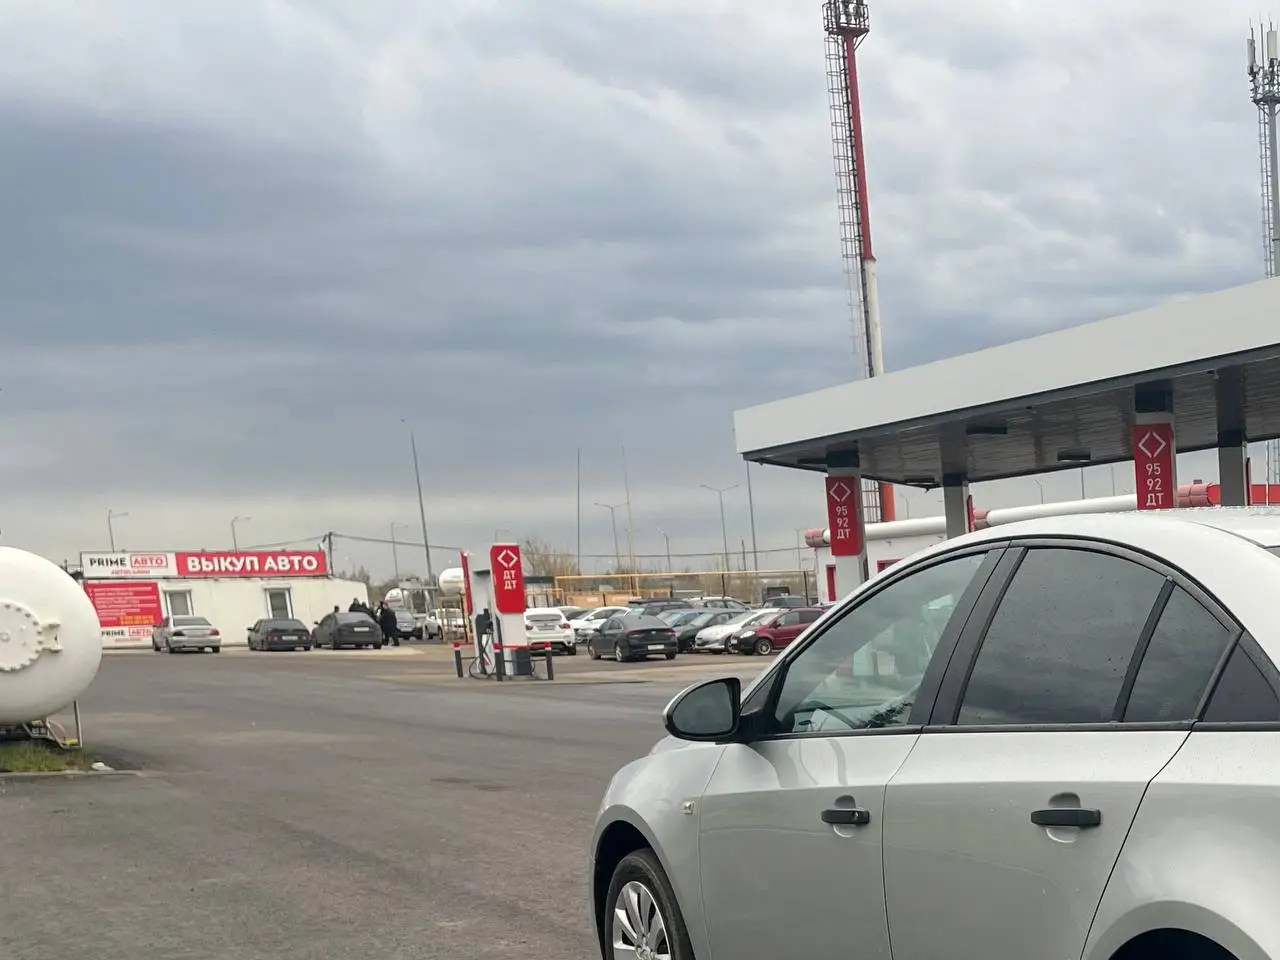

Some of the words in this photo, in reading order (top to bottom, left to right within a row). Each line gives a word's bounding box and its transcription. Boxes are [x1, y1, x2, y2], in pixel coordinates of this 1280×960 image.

[1146, 463, 1161, 476] 95
[1146, 478, 1162, 491] 92
[1146, 493, 1165, 507] ДТ
[835, 506, 848, 516] 95
[837, 518, 849, 528] 92
[836, 529, 851, 540] ДТ
[89, 557, 127, 567] PRIME
[187, 555, 260, 573] ВЫКУП
[263, 554, 318, 572] АВТО
[503, 570, 516, 580] ДТ
[504, 580, 517, 590] ДТ
